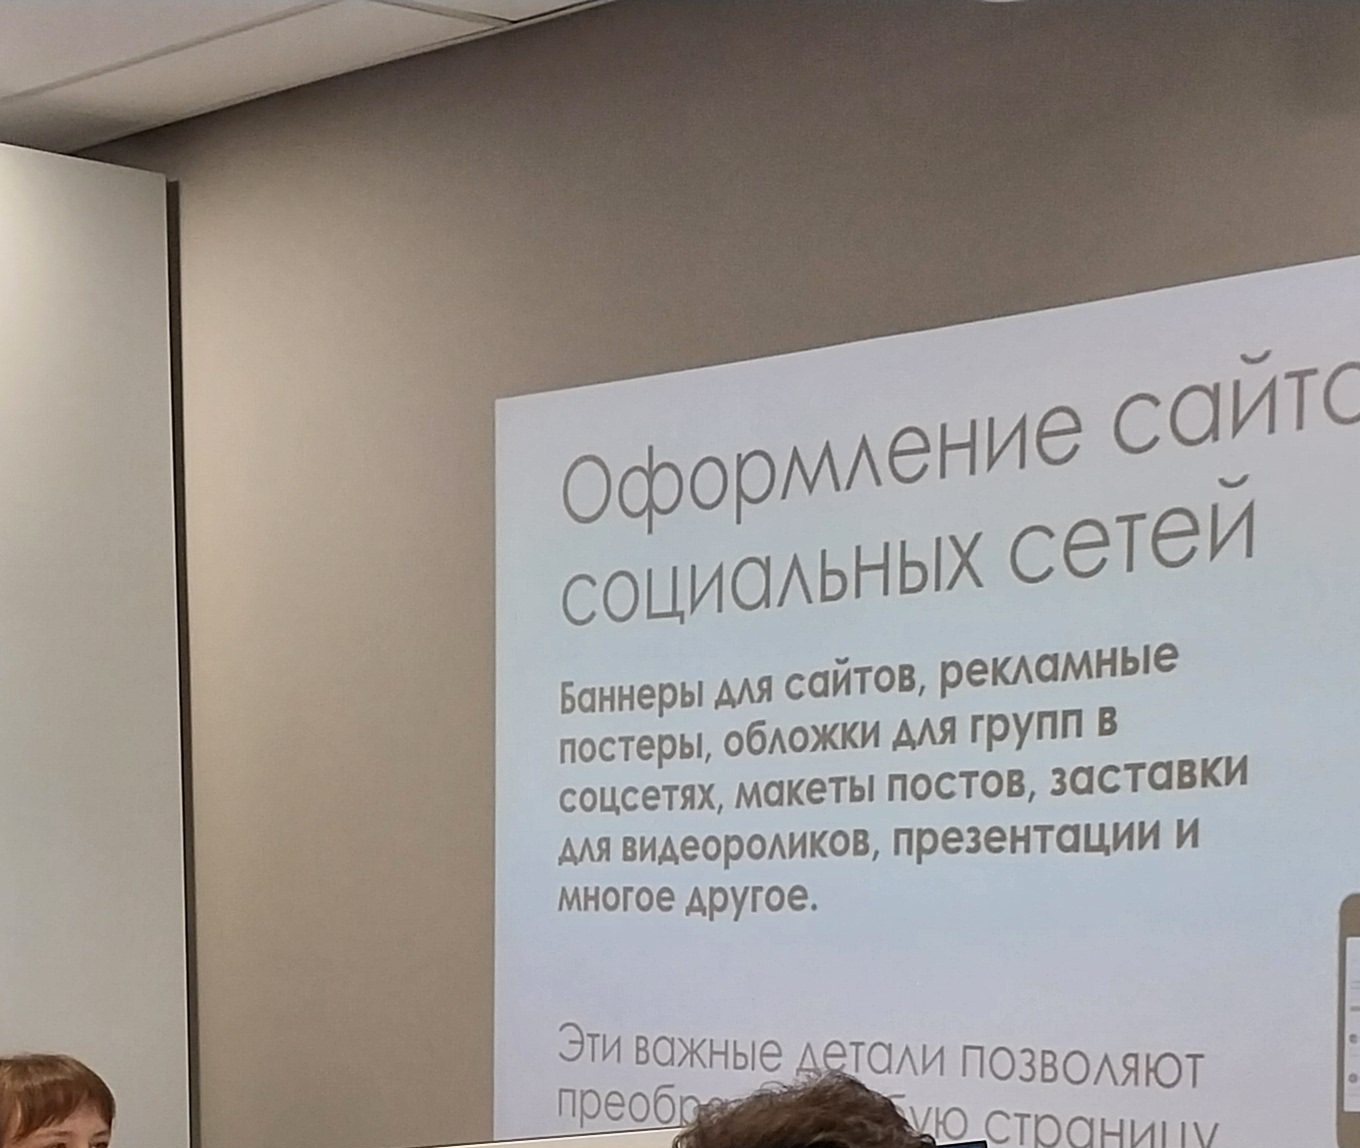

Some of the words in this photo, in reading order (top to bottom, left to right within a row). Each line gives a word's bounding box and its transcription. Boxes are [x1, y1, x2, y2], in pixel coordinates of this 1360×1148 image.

[563, 405, 1083, 535] Оформление
[562, 531, 984, 626] социальных
[1010, 474, 1255, 584] сетей
[561, 680, 703, 718] Баннеры
[714, 675, 773, 710] для
[785, 657, 926, 700] сайтов,
[940, 643, 1180, 699] рекламные
[560, 732, 711, 769] постеры,
[724, 720, 880, 757] обложки
[892, 716, 956, 752] для
[971, 708, 1083, 752] групп
[1098, 706, 1118, 736] в
[559, 783, 723, 816] соцсетях,
[735, 774, 874, 809] макеты
[888, 769, 1036, 803] постов,
[1050, 755, 1248, 796] заставки
[558, 837, 611, 866] для
[622, 829, 879, 870] видеороликов,
[894, 820, 1160, 865] презентации
[1176, 818, 1199, 849] и
[558, 886, 675, 912] многое
[685, 885, 817, 922] другое.
[559, 1022, 621, 1064] Эти
[636, 1035, 782, 1072] важные
[796, 1040, 944, 1077] детали
[962, 1045, 1205, 1089] позволяют
[558, 1084, 745, 1129] преобр
